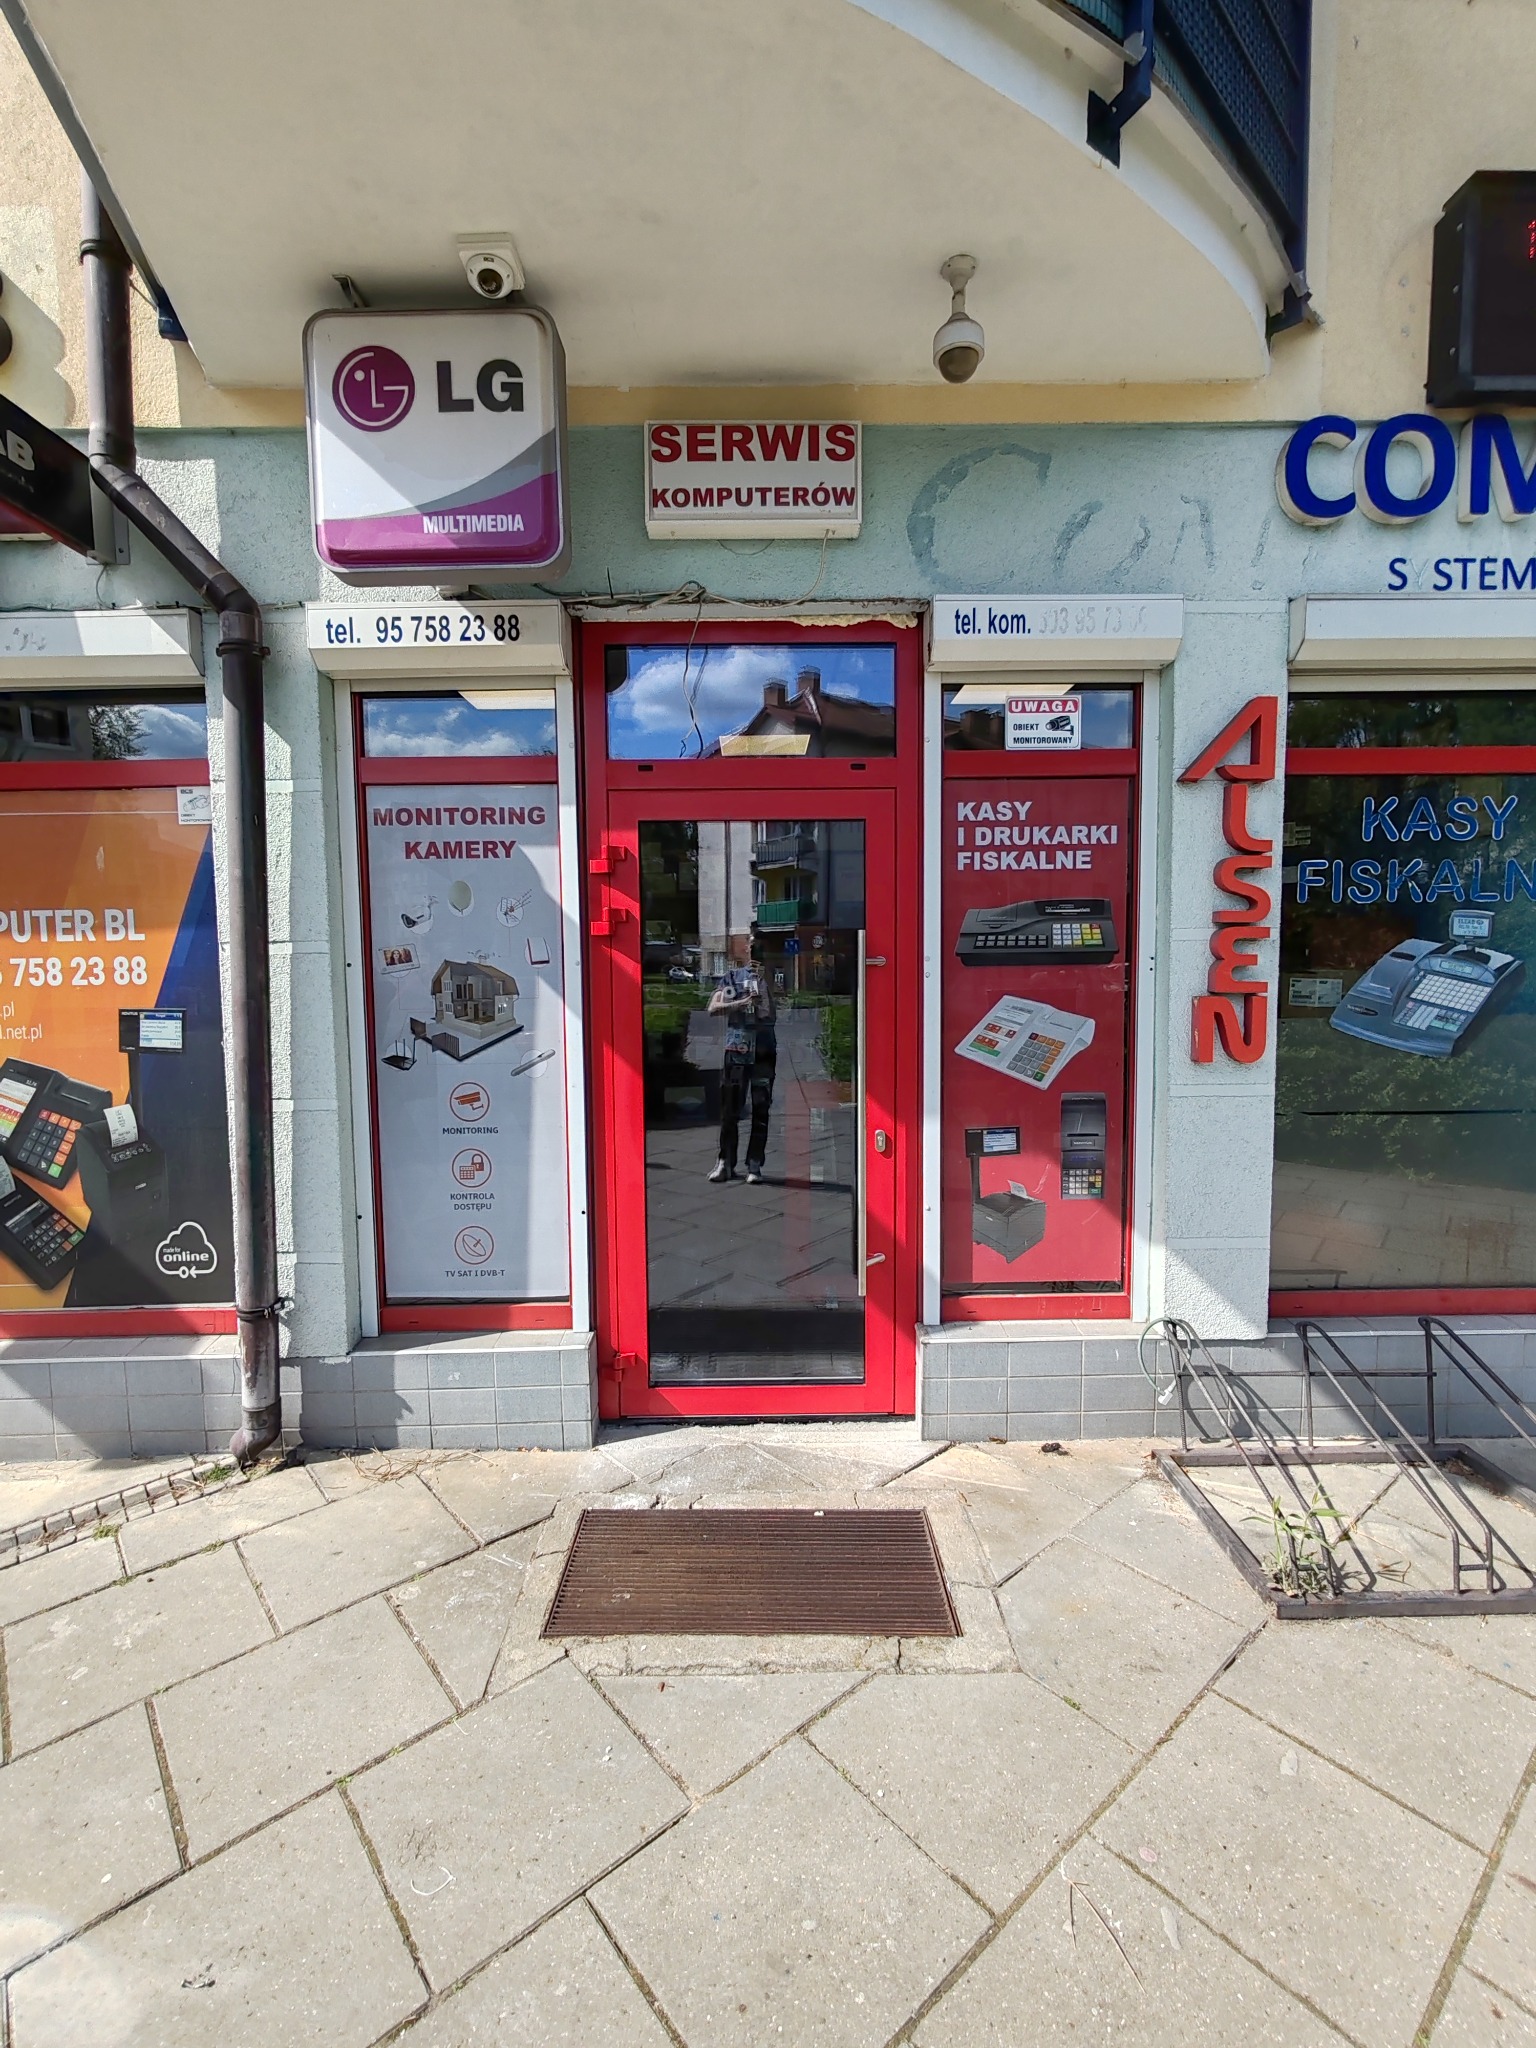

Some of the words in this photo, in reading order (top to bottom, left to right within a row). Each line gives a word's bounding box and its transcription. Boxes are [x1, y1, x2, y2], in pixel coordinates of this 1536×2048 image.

[436, 359, 524, 413] LG
[0, 429, 36, 472] B
[650, 424, 856, 463] SERWIS
[652, 482, 856, 509] KOMPUTERÓW
[422, 514, 525, 534] MULTIMEDIA
[325, 617, 362, 644] tel.
[376, 616, 403, 644] 95
[410, 616, 451, 643] 758
[459, 615, 485, 642] 23
[493, 614, 521, 642] 88
[954, 608, 982, 634] tel.
[988, 607, 1032, 635] kom.
[1011, 700, 1076, 713] UWAGA
[1013, 723, 1040, 731] OBIEKT
[1013, 736, 1073, 745] MONITOROWANY
[373, 806, 546, 827] MONITORING
[957, 801, 1033, 822] KASY
[1361, 795, 1519, 843] KASY
[957, 827, 965, 847] I
[975, 825, 1118, 847] DRUKARKI
[404, 840, 517, 860] KAMERY
[957, 850, 1092, 871] FISKALNE
[1296, 857, 1536, 905] FISKALN
[104, 908, 146, 942] BL
[9, 957, 63, 987] 758
[70, 956, 106, 986] 23
[113, 955, 148, 986] 88
[442, 1126, 499, 1135] MONITORING
[450, 1192, 495, 1201] KONTROLA
[453, 1202, 492, 1211] DOSTĘPU
[163, 1250, 210, 1263] online
[445, 1270, 456, 1278] TV
[480, 1269, 506, 1277] DVB-T
